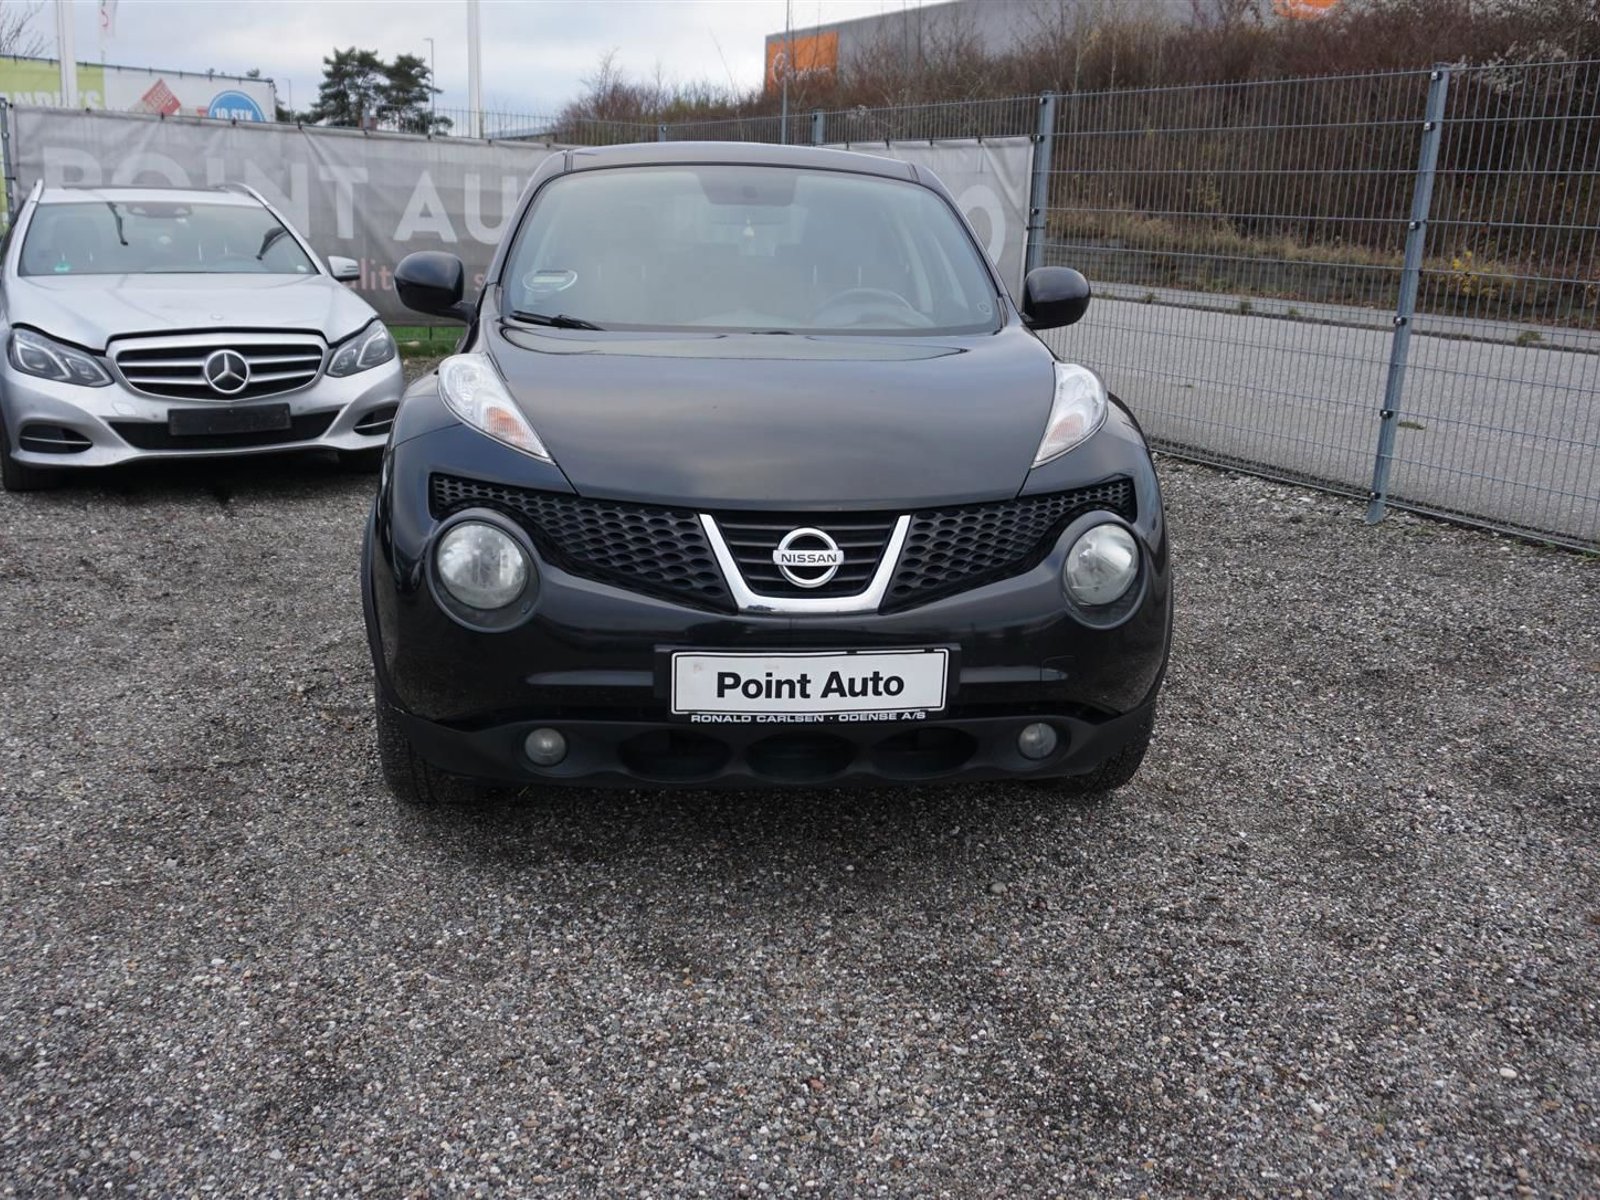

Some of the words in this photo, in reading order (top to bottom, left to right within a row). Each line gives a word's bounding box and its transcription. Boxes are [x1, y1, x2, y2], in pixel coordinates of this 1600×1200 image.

[780, 552, 838, 564] NISSAN
[716, 671, 812, 699] Point
[819, 670, 905, 699] Auto
[690, 714, 752, 723] RONALD
[756, 714, 825, 723] CARLSEN
[838, 713, 898, 722] ODENSE
[901, 711, 927, 720] A/S
